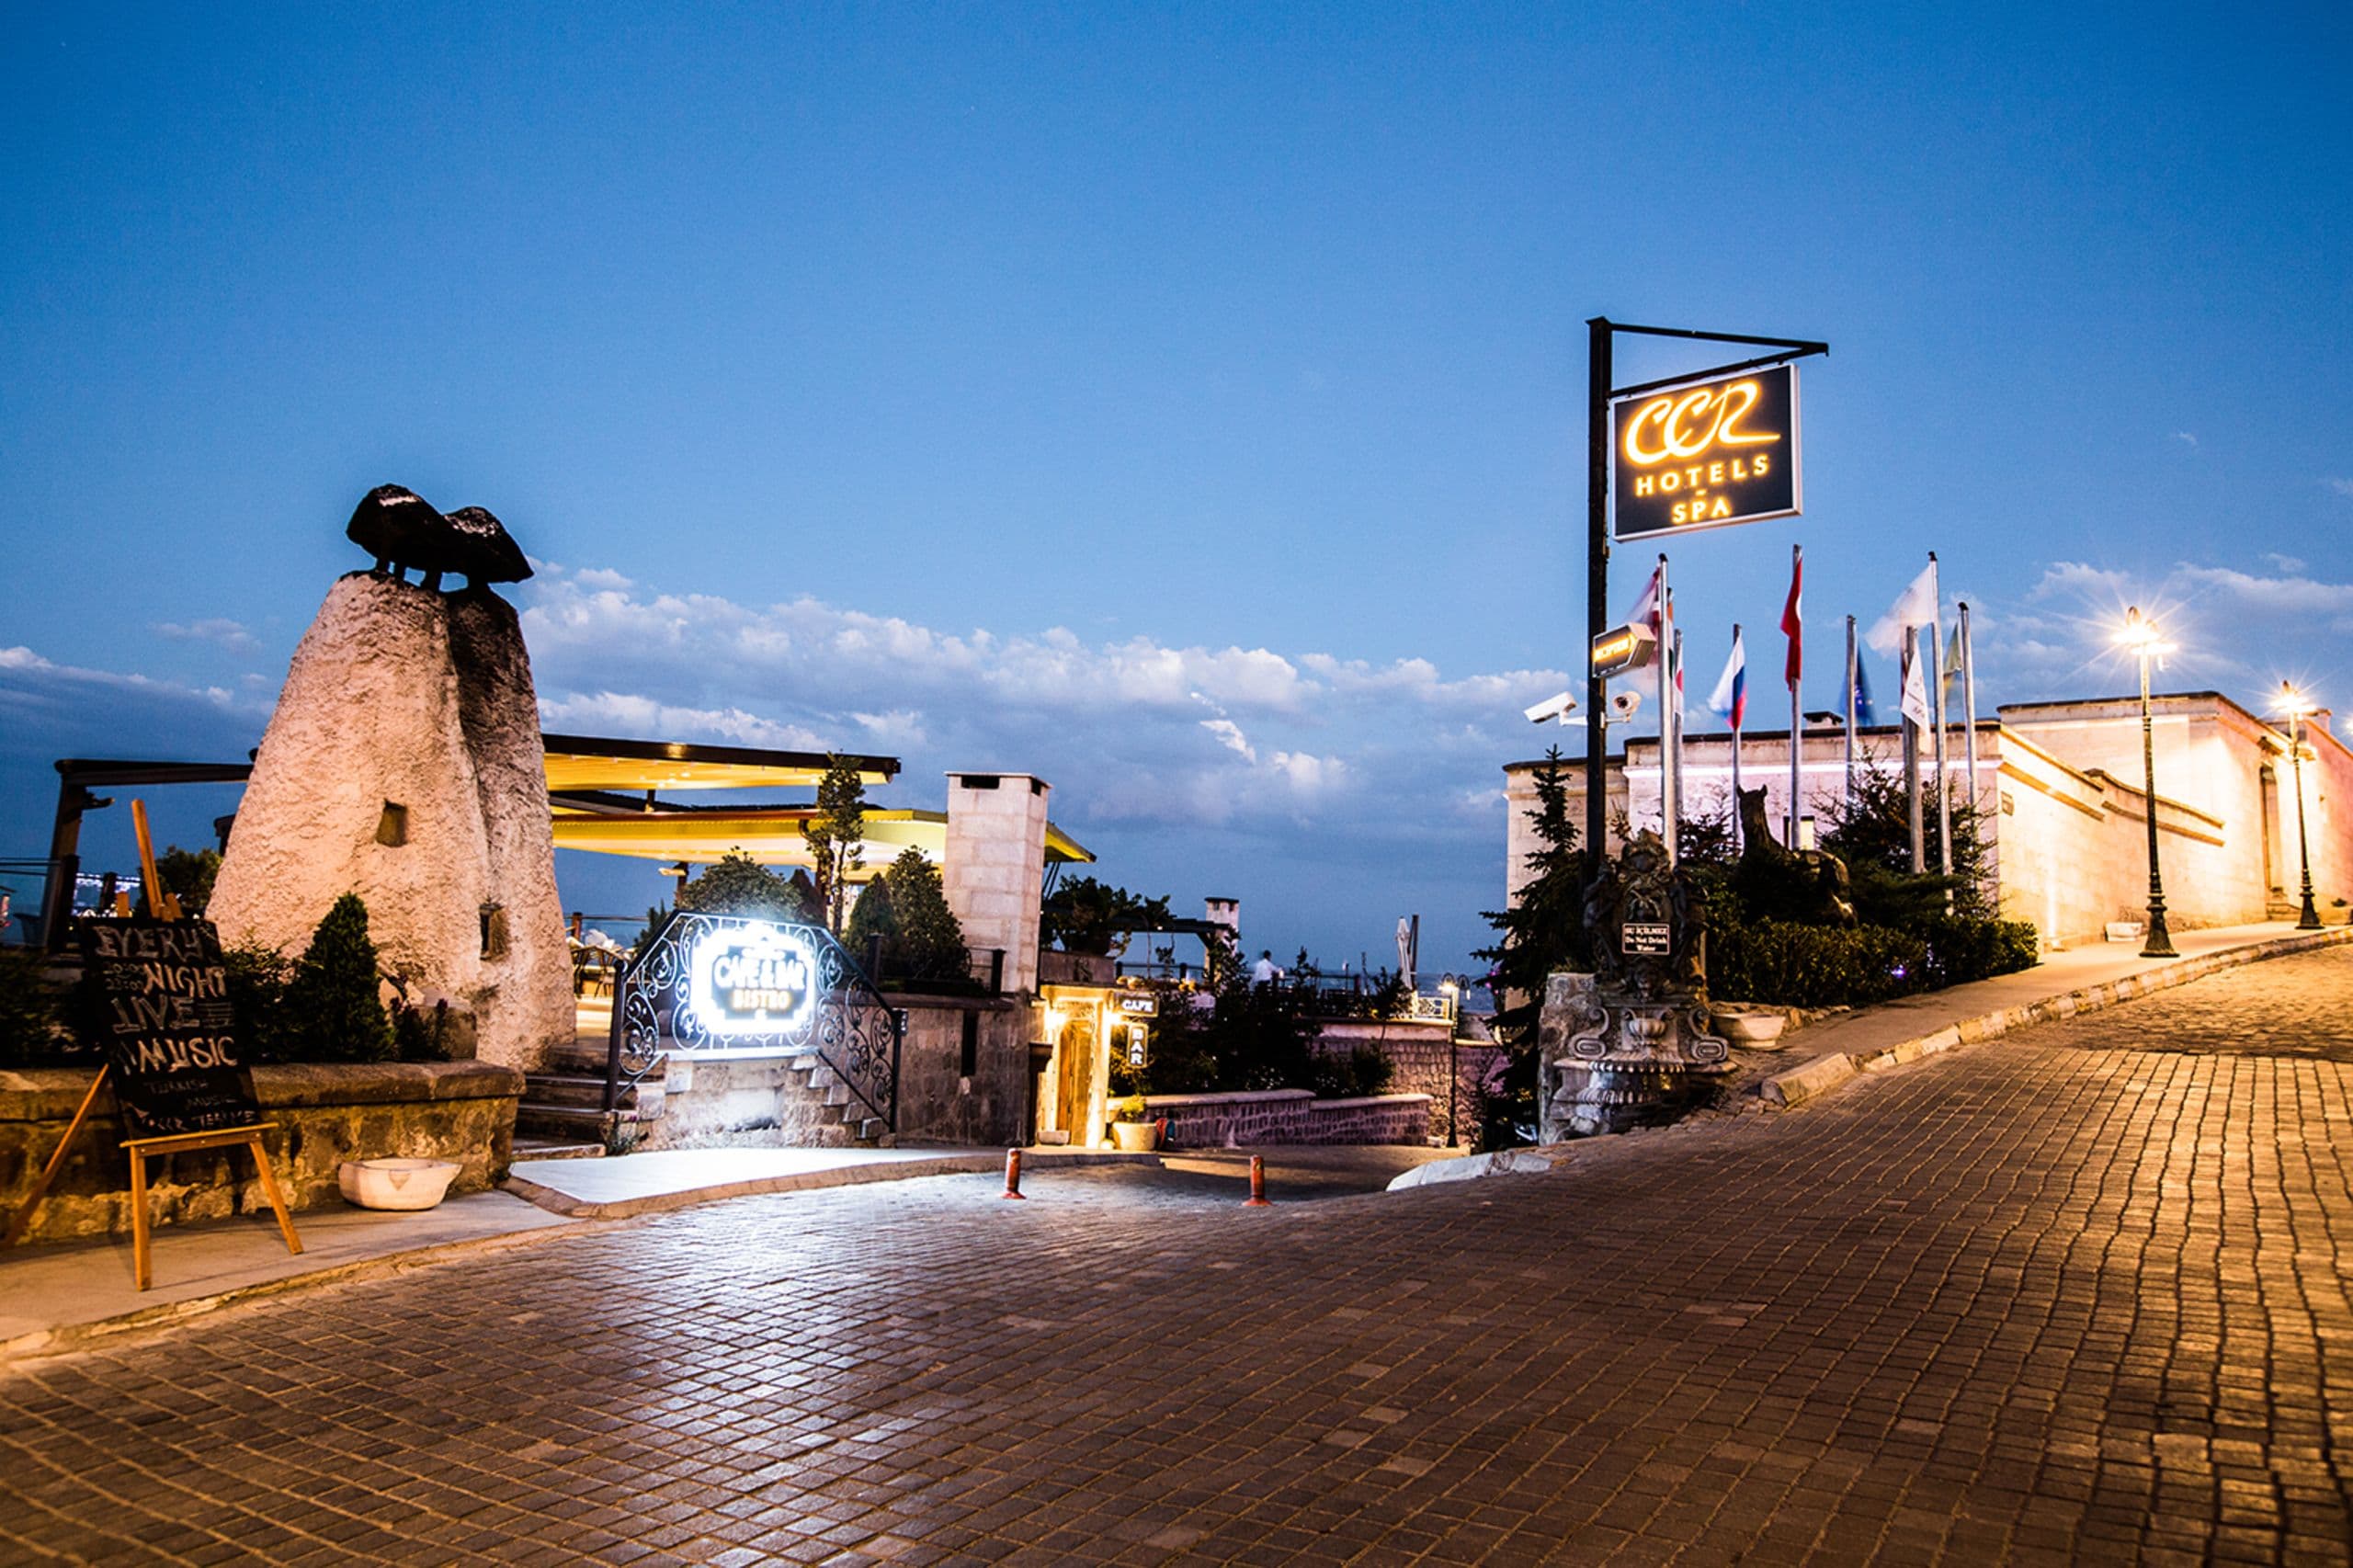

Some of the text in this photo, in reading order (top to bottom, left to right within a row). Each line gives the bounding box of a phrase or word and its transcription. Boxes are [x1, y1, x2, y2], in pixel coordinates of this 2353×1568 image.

[1625, 381, 1781, 464] CCR
[1635, 455, 1769, 497] HOTELS
[1672, 496, 1732, 524] SPA
[94, 926, 204, 963] EVERY
[143, 961, 228, 999] NIGHT
[111, 994, 200, 1034] LIVE
[137, 1036, 238, 1074] MUSIC
[1131, 1028, 1143, 1064] BAR
